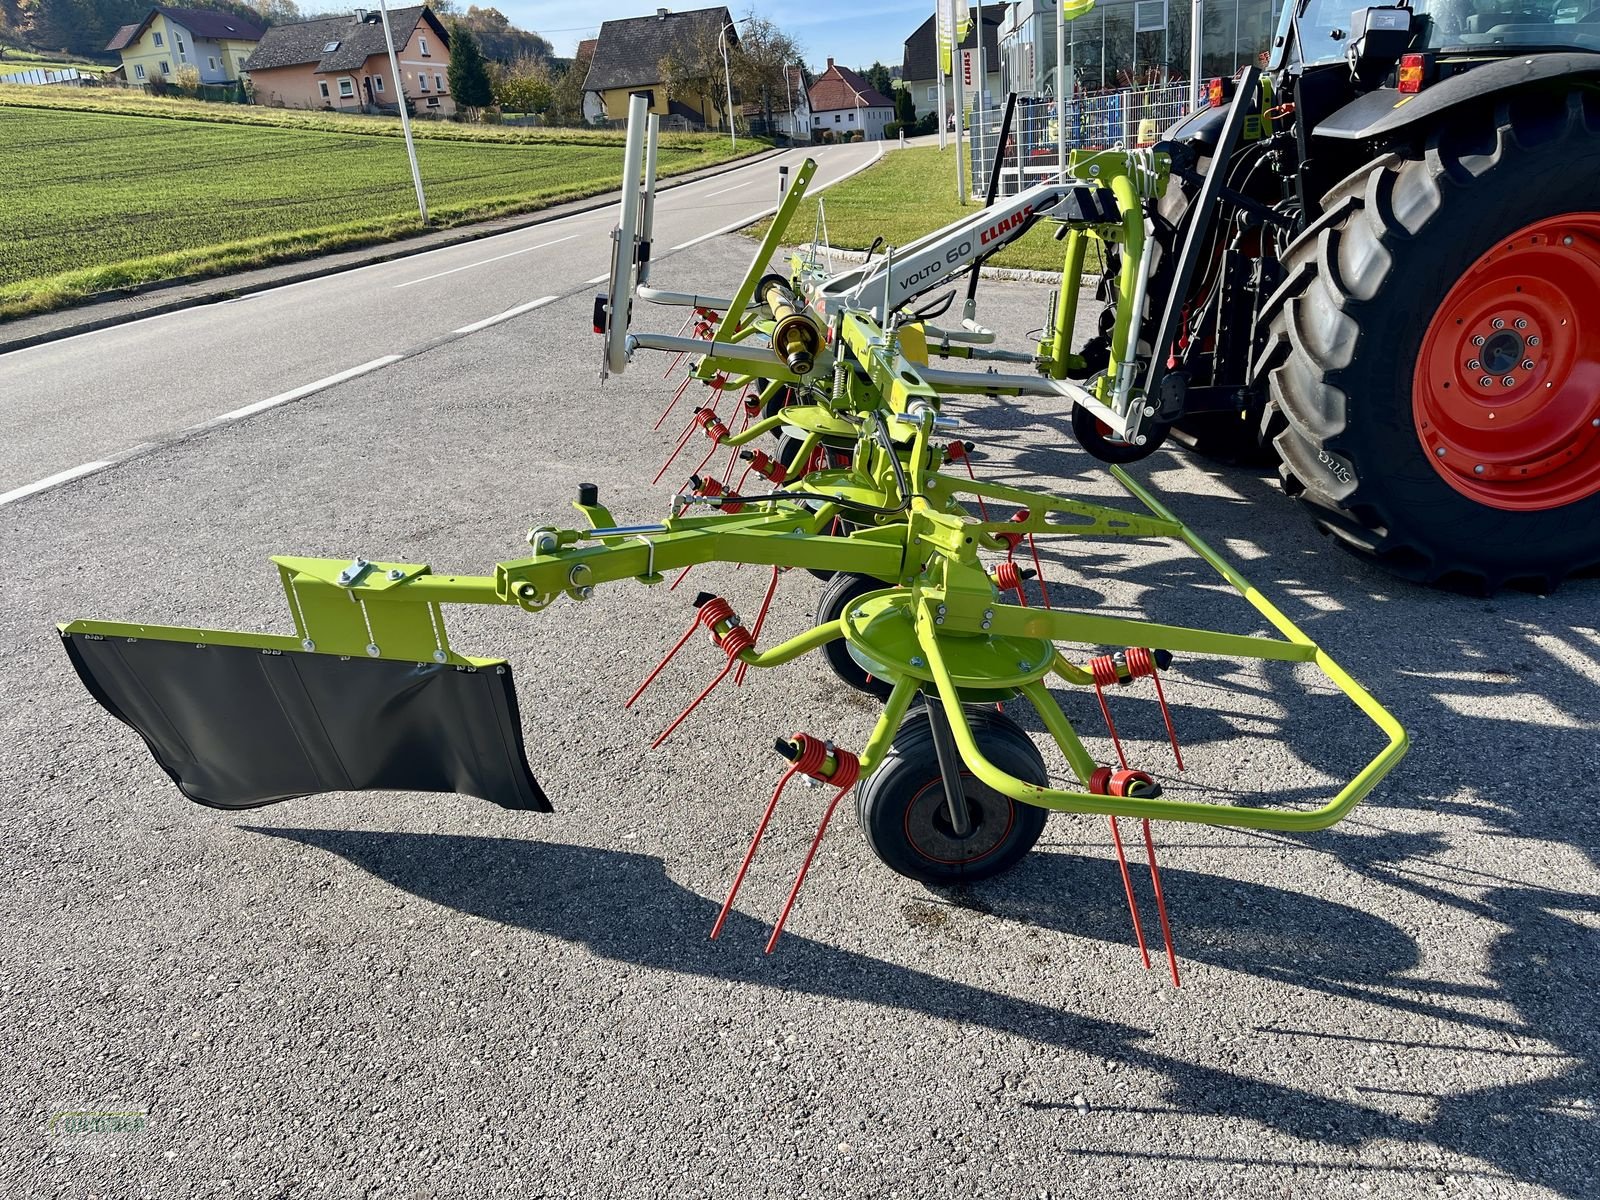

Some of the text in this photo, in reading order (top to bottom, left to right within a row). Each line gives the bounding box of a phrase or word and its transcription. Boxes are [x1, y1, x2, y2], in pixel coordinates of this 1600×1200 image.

[980, 204, 1035, 245] CLAAS
[899, 241, 972, 290] VOLTO 60
